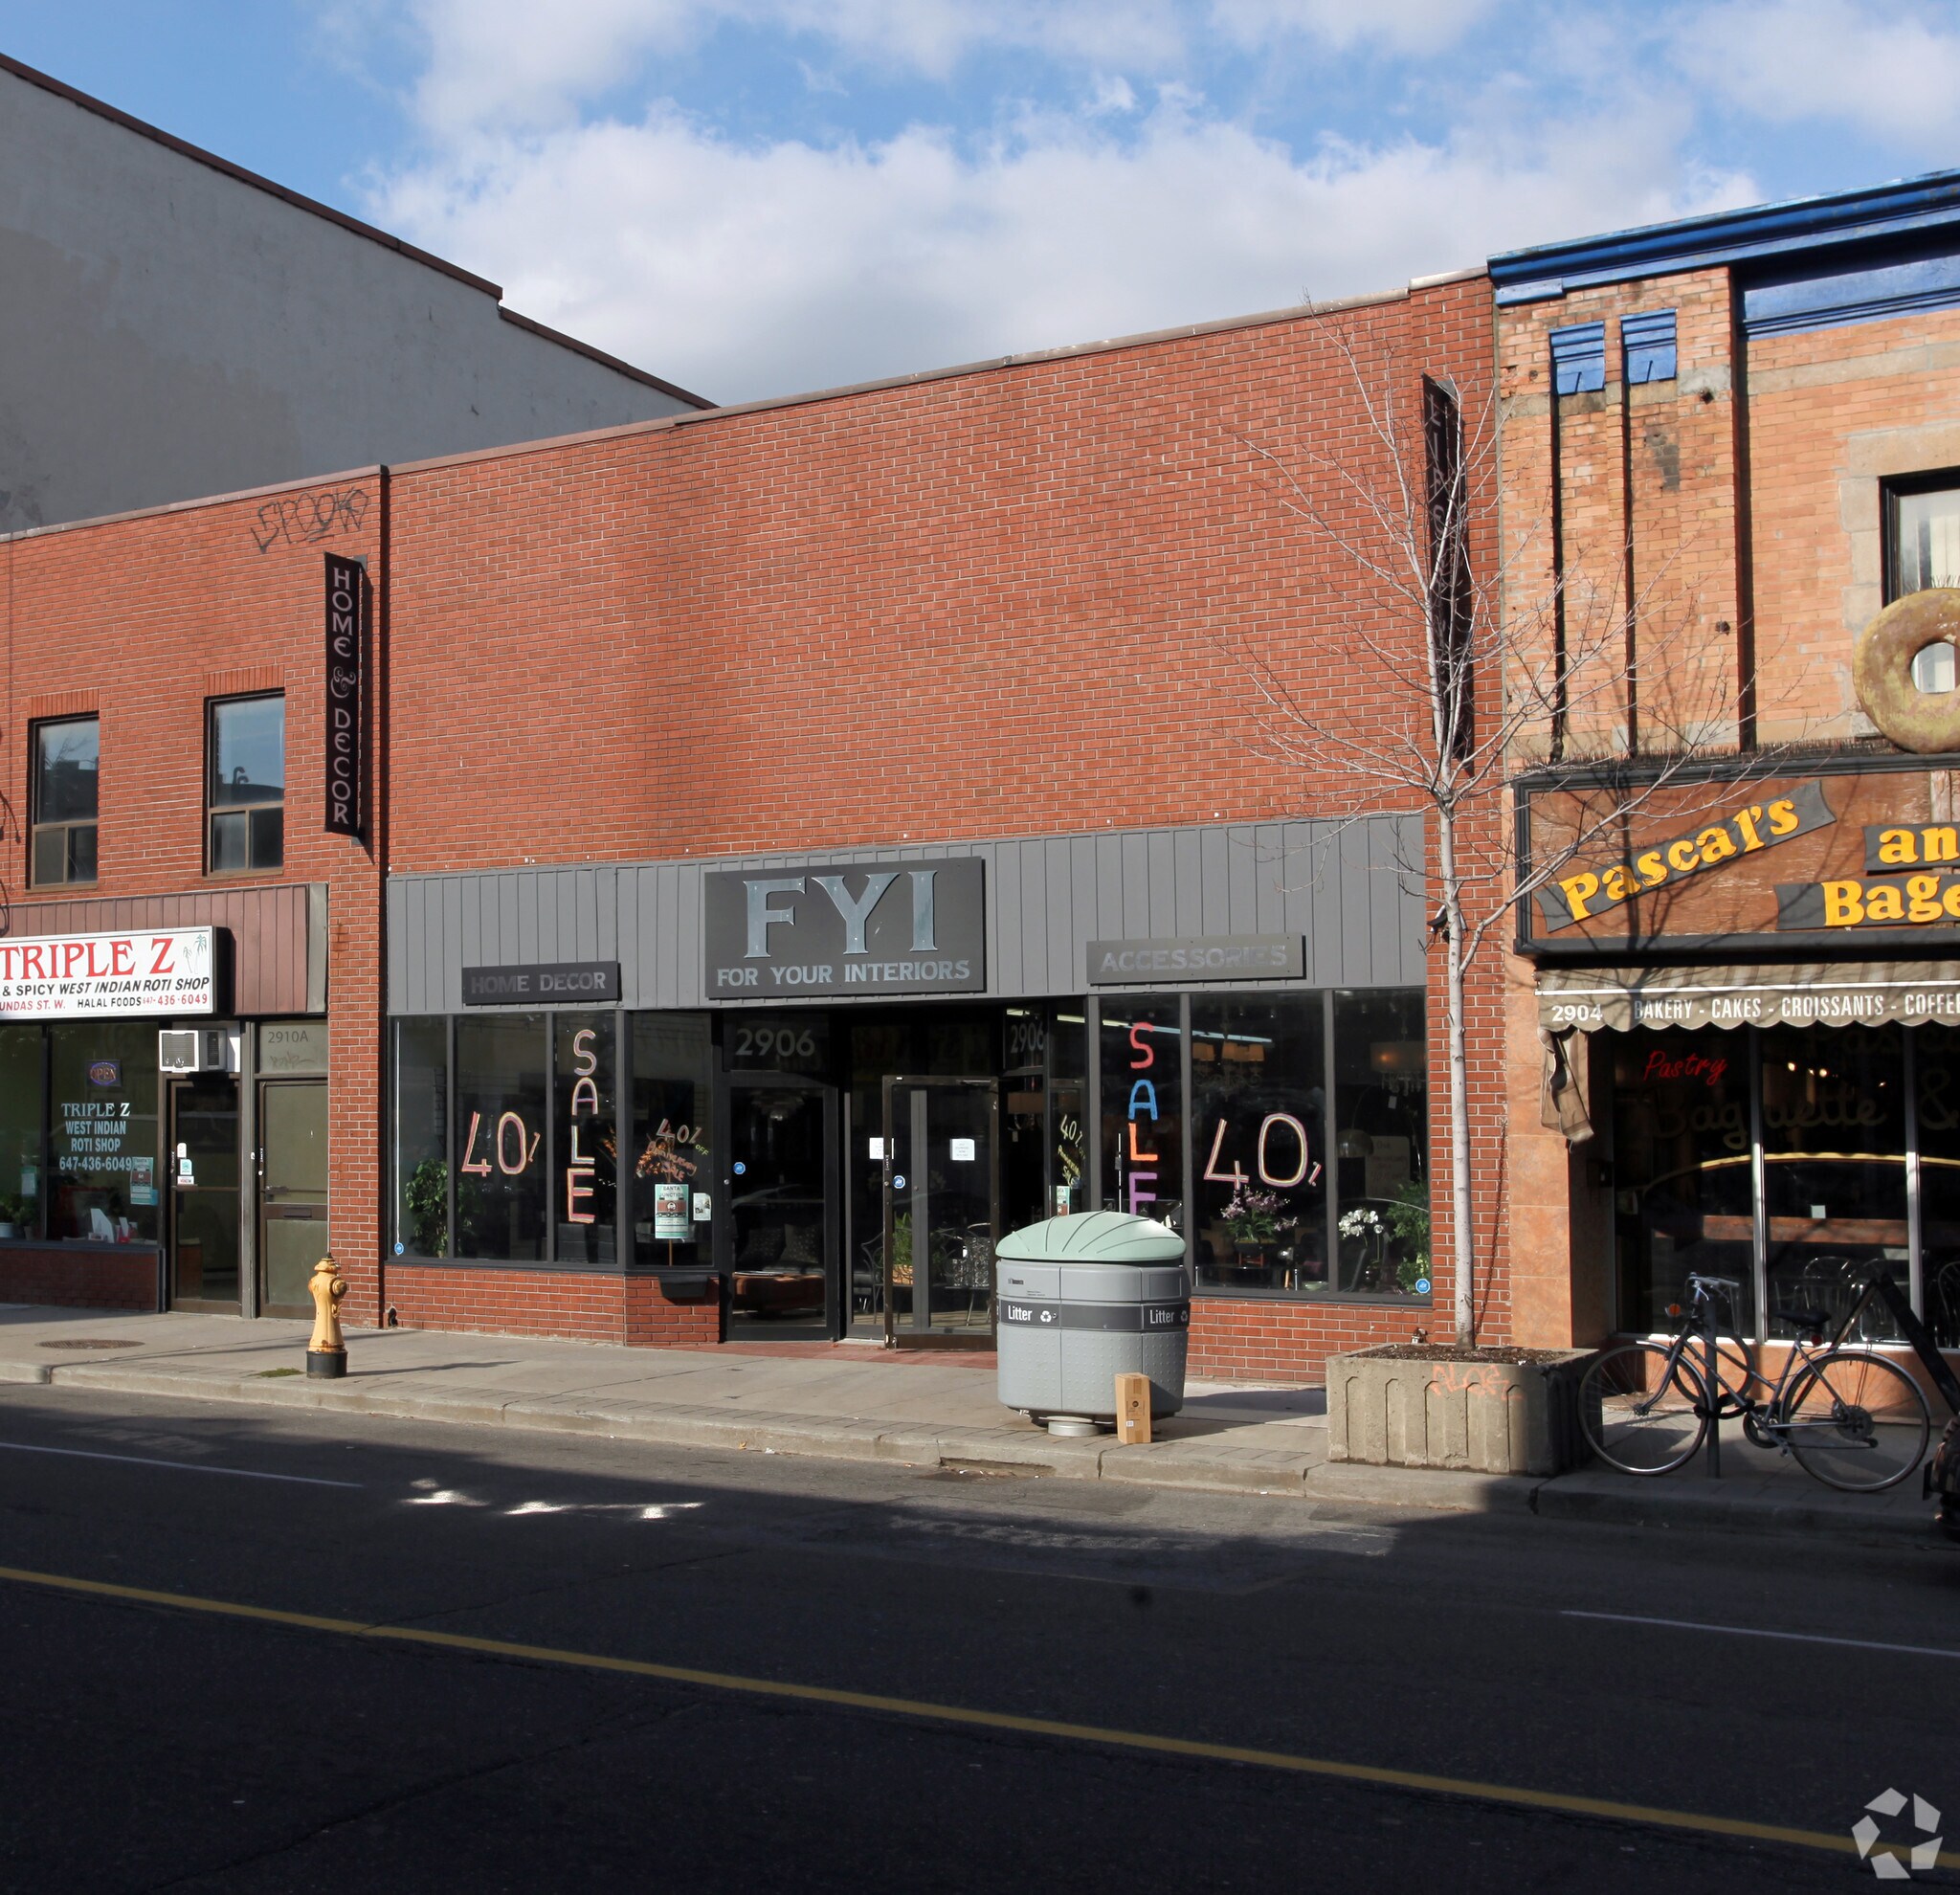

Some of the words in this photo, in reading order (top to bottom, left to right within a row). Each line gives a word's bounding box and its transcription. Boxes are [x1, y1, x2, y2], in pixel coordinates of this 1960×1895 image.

[332, 568, 353, 658] HOME
[330, 666, 356, 699] &
[332, 708, 351, 824] DECOR
[1558, 799, 1800, 922] Pascal's
[743, 870, 938, 959] FYI
[0, 940, 136, 980] TRIPLE
[149, 938, 175, 974] Z
[1102, 946, 1287, 972] ACCESSORIES
[2, 986, 11, 996] &
[16, 984, 55, 996] SPICY
[59, 982, 92, 994] WEST
[95, 980, 142, 993] INDIAN
[144, 979, 171, 992] ROTI
[175, 976, 210, 991] SHOP
[471, 975, 529, 994] HOME
[540, 971, 606, 992] DECOR
[717, 968, 758, 987] FOR
[770, 965, 833, 985] YOUR
[844, 960, 970, 983] INTERIORS
[78, 997, 108, 1009] HALAL
[111, 996, 142, 1007] FOODS
[1551, 1003, 1603, 1022] 2904
[1634, 998, 1692, 1019] BAKERY
[1711, 998, 1762, 1018] CAKES
[1781, 994, 1883, 1016] CROISSANTS
[268, 1030, 309, 1044] 2910A
[735, 1028, 815, 1057] 2906
[1010, 1021, 1044, 1054] 2906
[89, 1066, 117, 1081] OPEN
[1643, 1050, 1727, 1085] Pastry
[61, 1103, 116, 1117] TRIPLE
[120, 1103, 131, 1117] Z
[65, 1121, 92, 1135] WEST
[94, 1121, 126, 1134] INDIAN
[568, 1029, 598, 1223] SALE
[71, 1138, 93, 1151] ROTI
[95, 1138, 121, 1151] SHOP
[59, 1156, 132, 1171] 647-436-6049
[1008, 1304, 1034, 1321] Litter
[1149, 1309, 1175, 1324] Litter
